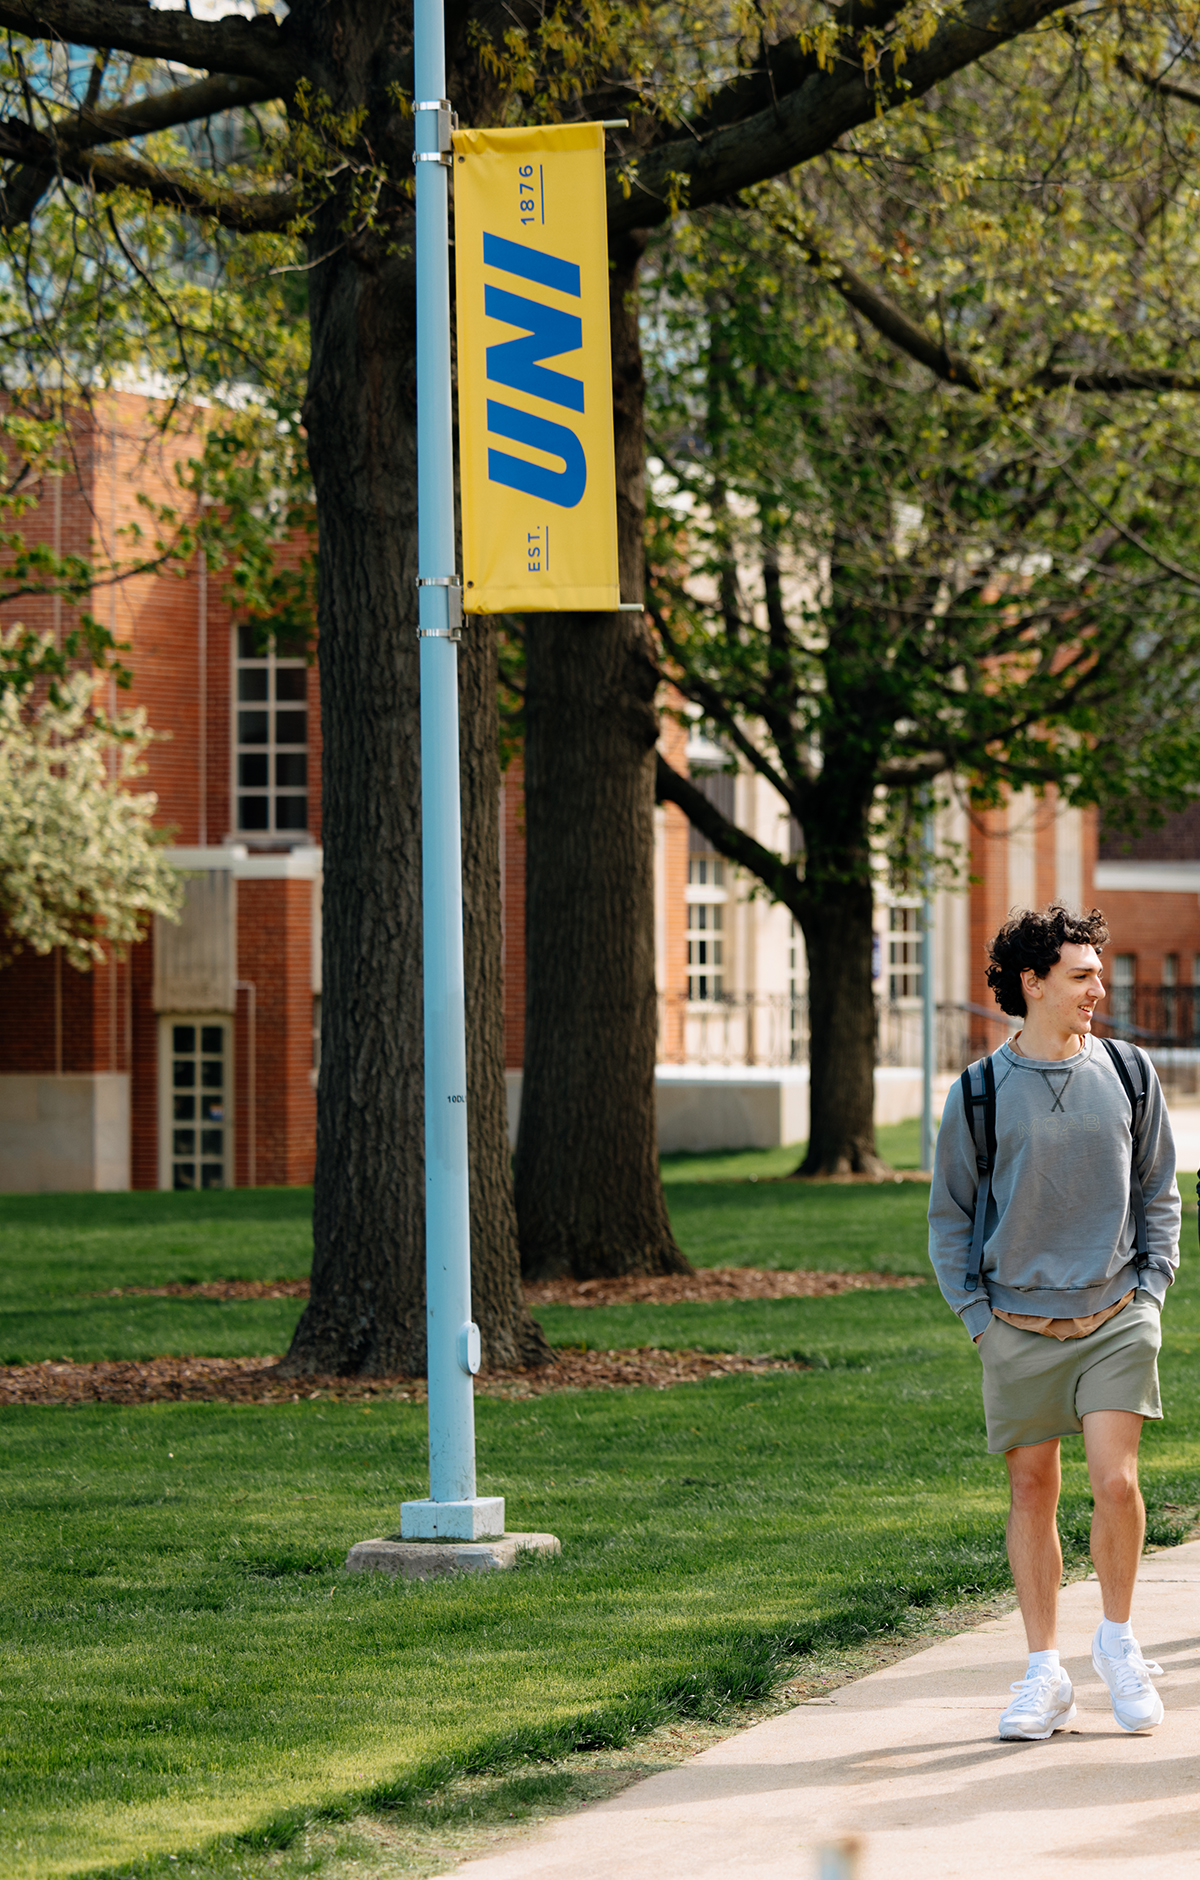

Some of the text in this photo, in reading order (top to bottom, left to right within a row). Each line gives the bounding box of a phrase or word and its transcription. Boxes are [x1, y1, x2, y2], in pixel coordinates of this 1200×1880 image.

[518, 164, 535, 226] 1876
[482, 231, 587, 509] UNI
[527, 525, 541, 572] EST.
[1017, 1114, 1101, 1139] MOAB
